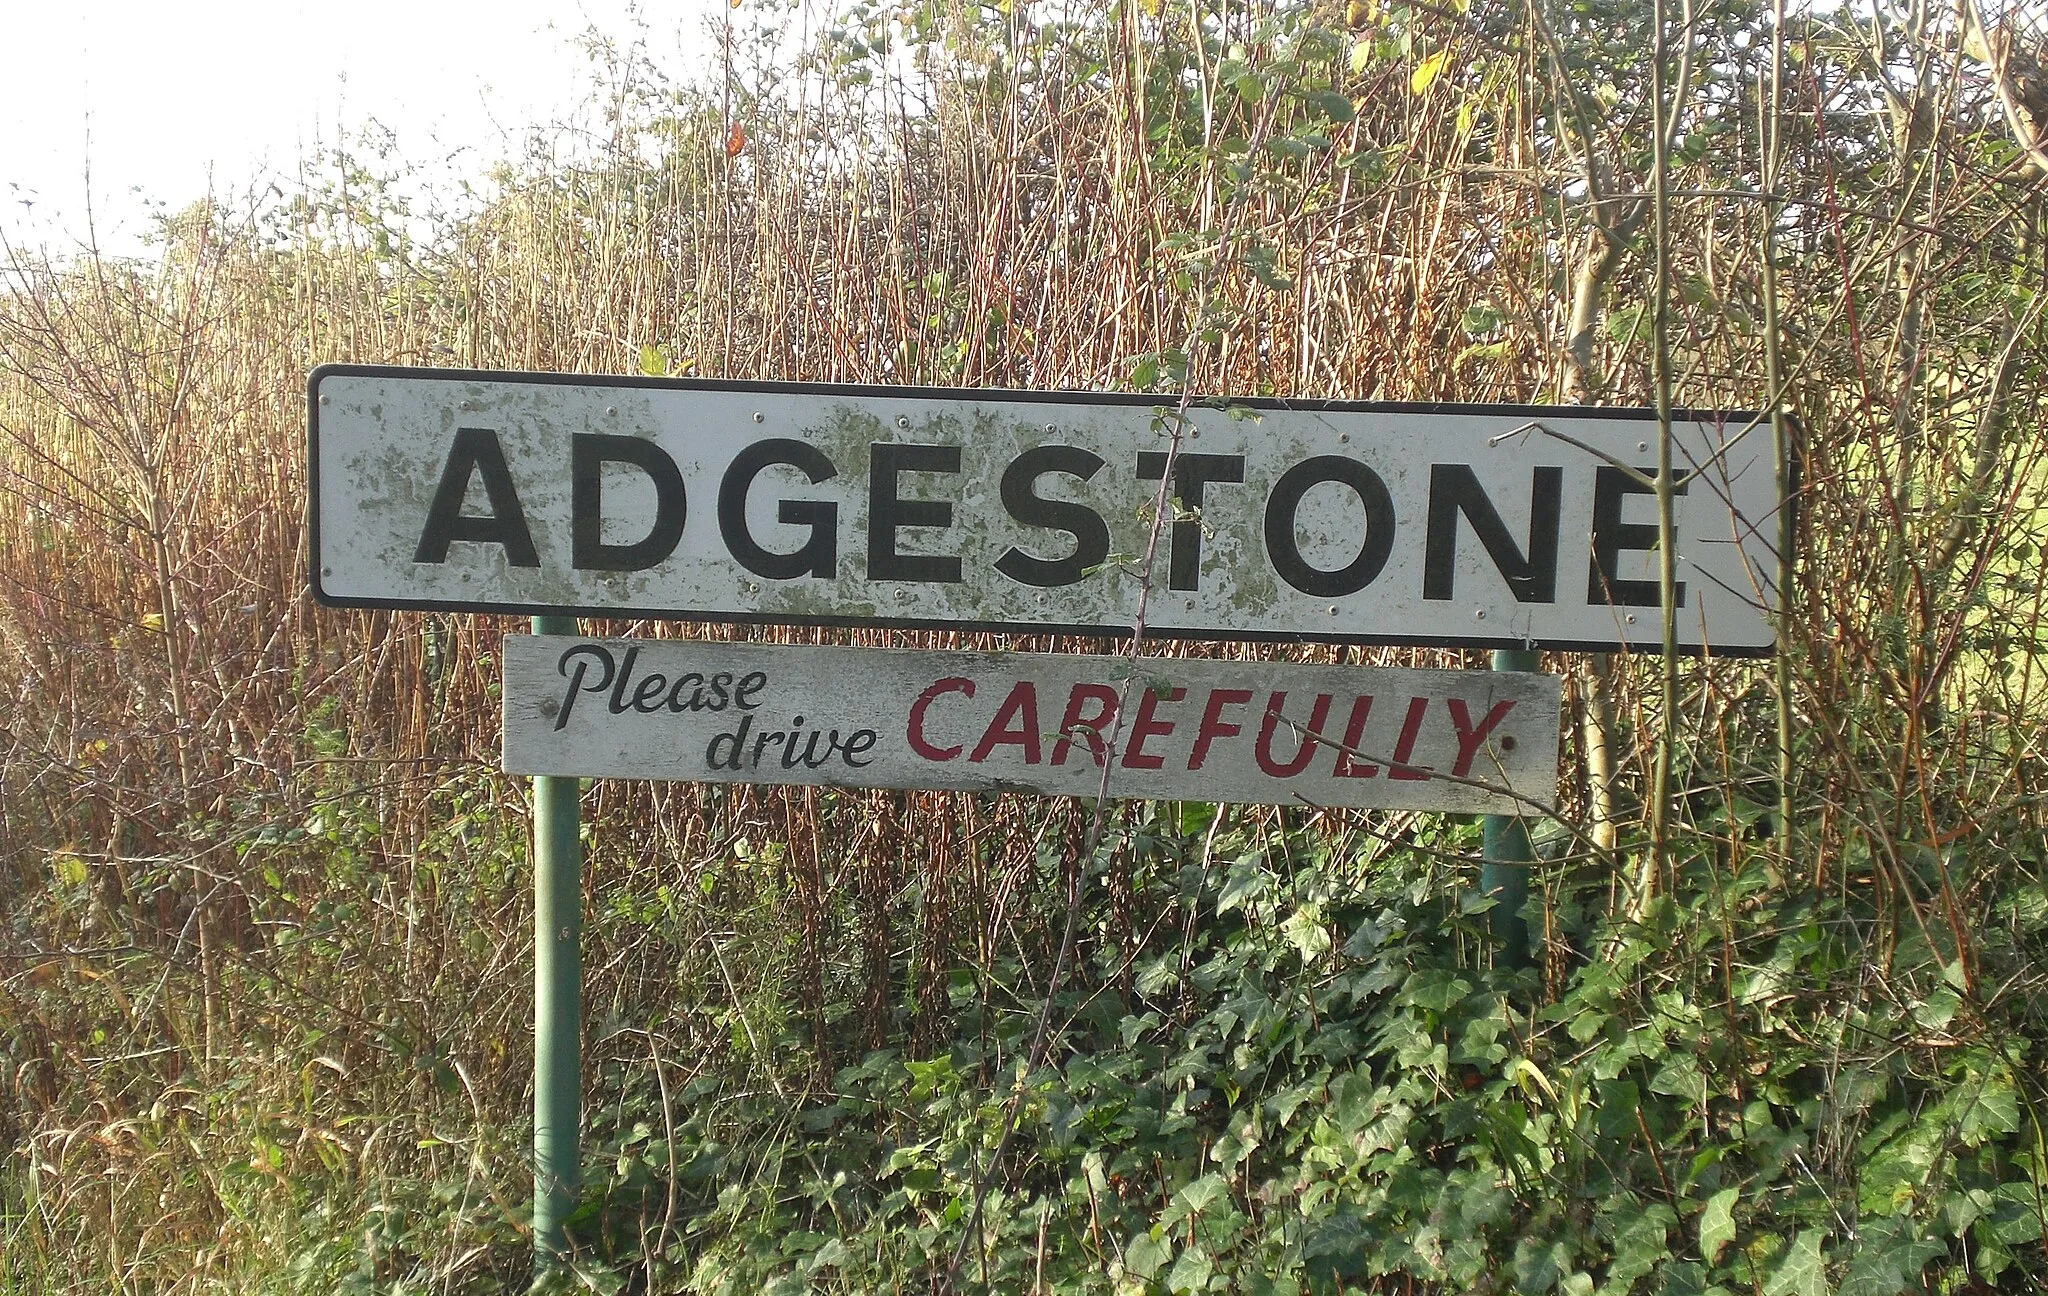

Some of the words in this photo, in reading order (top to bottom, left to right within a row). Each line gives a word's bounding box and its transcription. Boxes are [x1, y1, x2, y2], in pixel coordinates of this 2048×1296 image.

[413, 428, 1689, 607] ADGESTONE
[557, 644, 767, 731] Please
[707, 716, 876, 771] drive
[907, 677, 1516, 781] CAREFULLY
